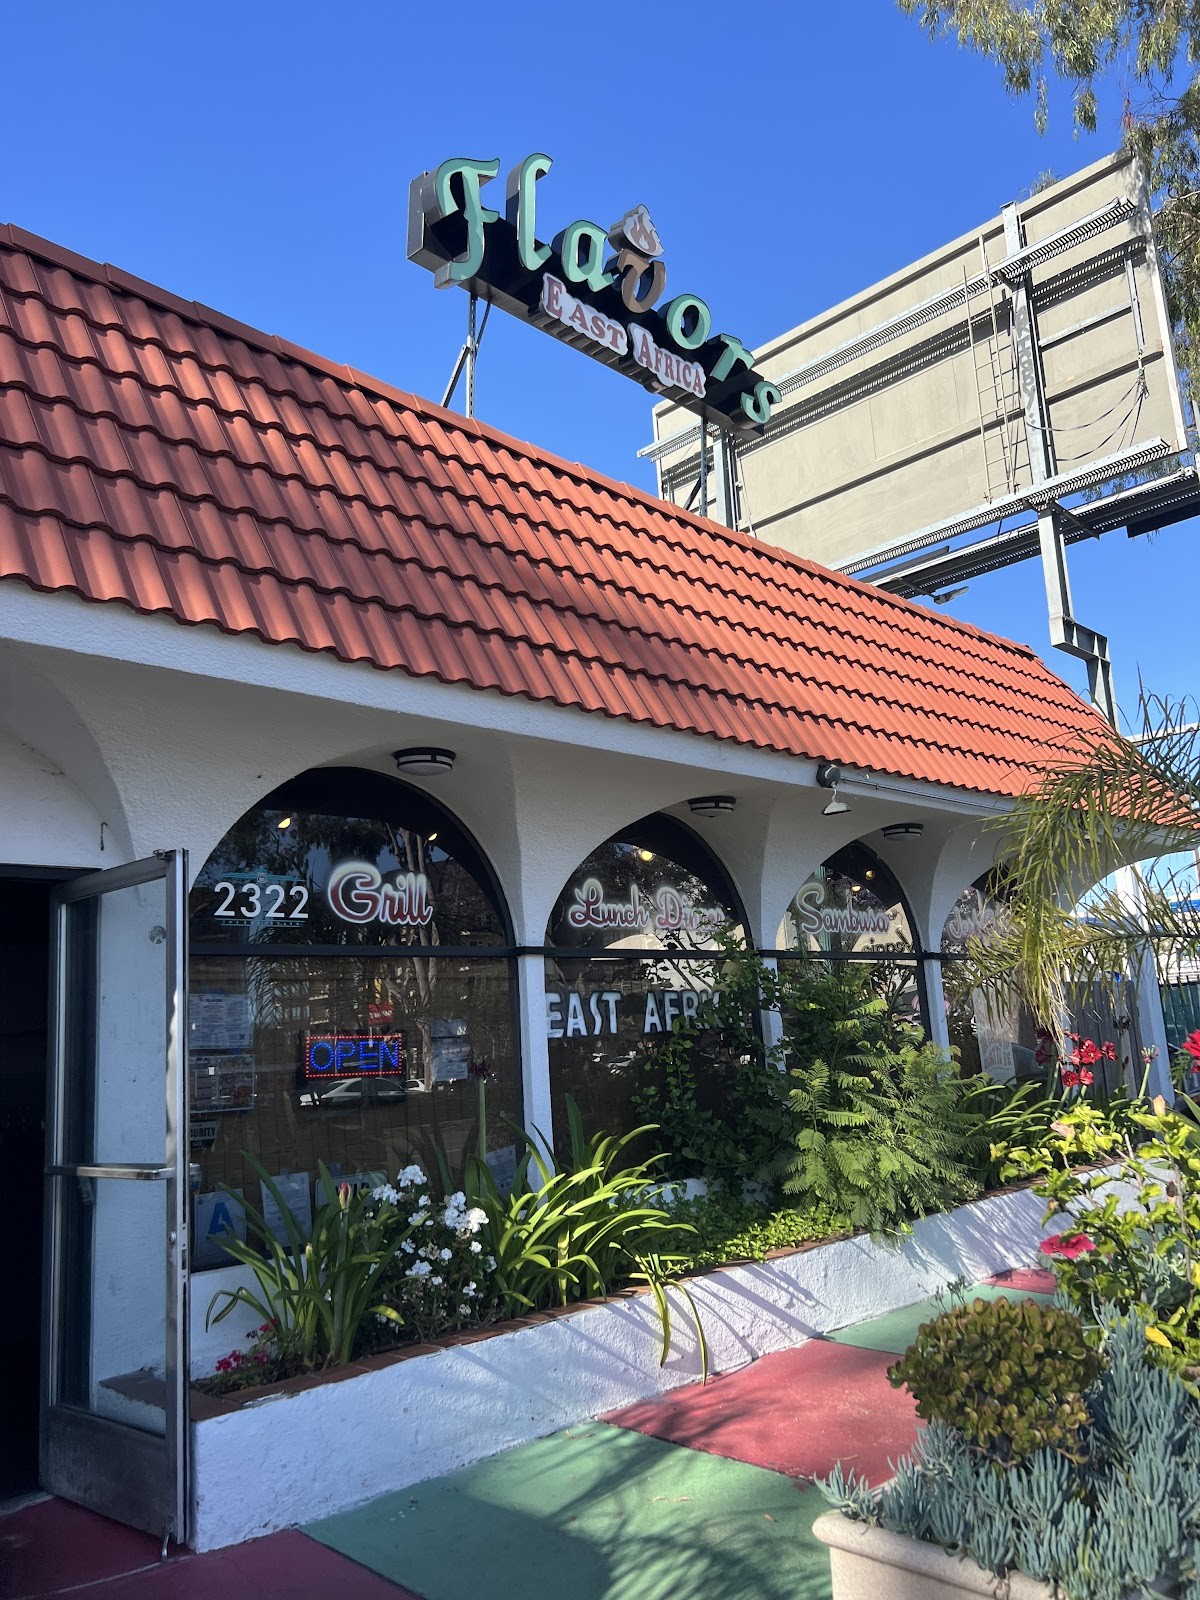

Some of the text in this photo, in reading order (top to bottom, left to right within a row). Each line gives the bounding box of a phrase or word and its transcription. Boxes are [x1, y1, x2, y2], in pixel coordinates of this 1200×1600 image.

[436, 153, 782, 425] Flavors
[543, 276, 705, 397] EAST AFRICA
[213, 881, 309, 919] 2322
[328, 862, 434, 926] Grill
[569, 877, 650, 929] Lunch
[796, 882, 891, 934] Sambusa
[546, 992, 622, 1038] EAST
[308, 1041, 399, 1071] OPEN
[207, 1202, 237, 1238] A
